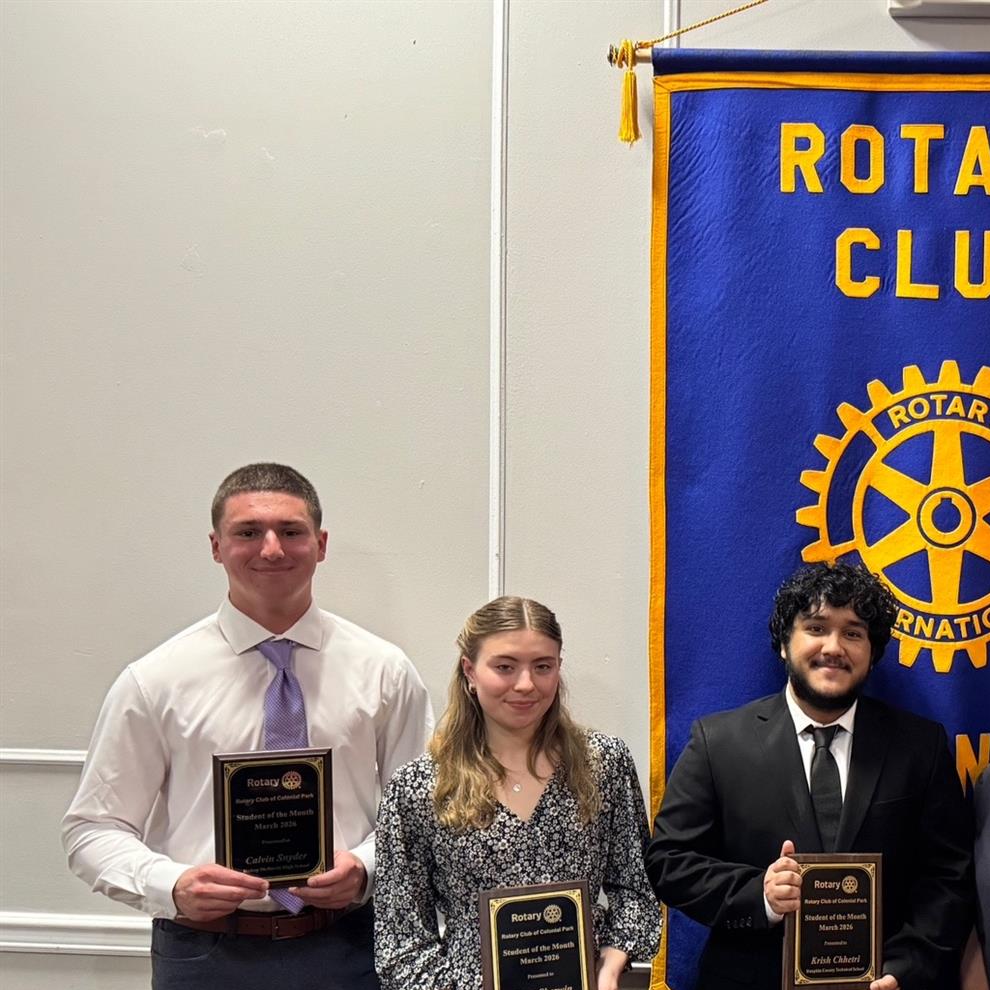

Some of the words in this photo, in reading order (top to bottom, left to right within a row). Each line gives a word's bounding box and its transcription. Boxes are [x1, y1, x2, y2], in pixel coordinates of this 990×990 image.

[247, 778, 280, 788] Rotary
[236, 813, 265, 821] Student
[267, 811, 275, 819] of
[276, 810, 288, 818] the
[289, 808, 314, 817] Month
[814, 880, 840, 890] Rotary
[511, 911, 542, 922] Rotary
[804, 913, 828, 921] Student
[847, 912, 867, 920] Month
[839, 923, 853, 931] 2026
[501, 932, 519, 940] Rotary
[503, 948, 531, 957] Student
[551, 942, 575, 951] Month
[520, 956, 543, 965] March
[544, 954, 560, 962] 2026
[811, 956, 831, 965] Krish
[832, 955, 860, 964] Chhetri
